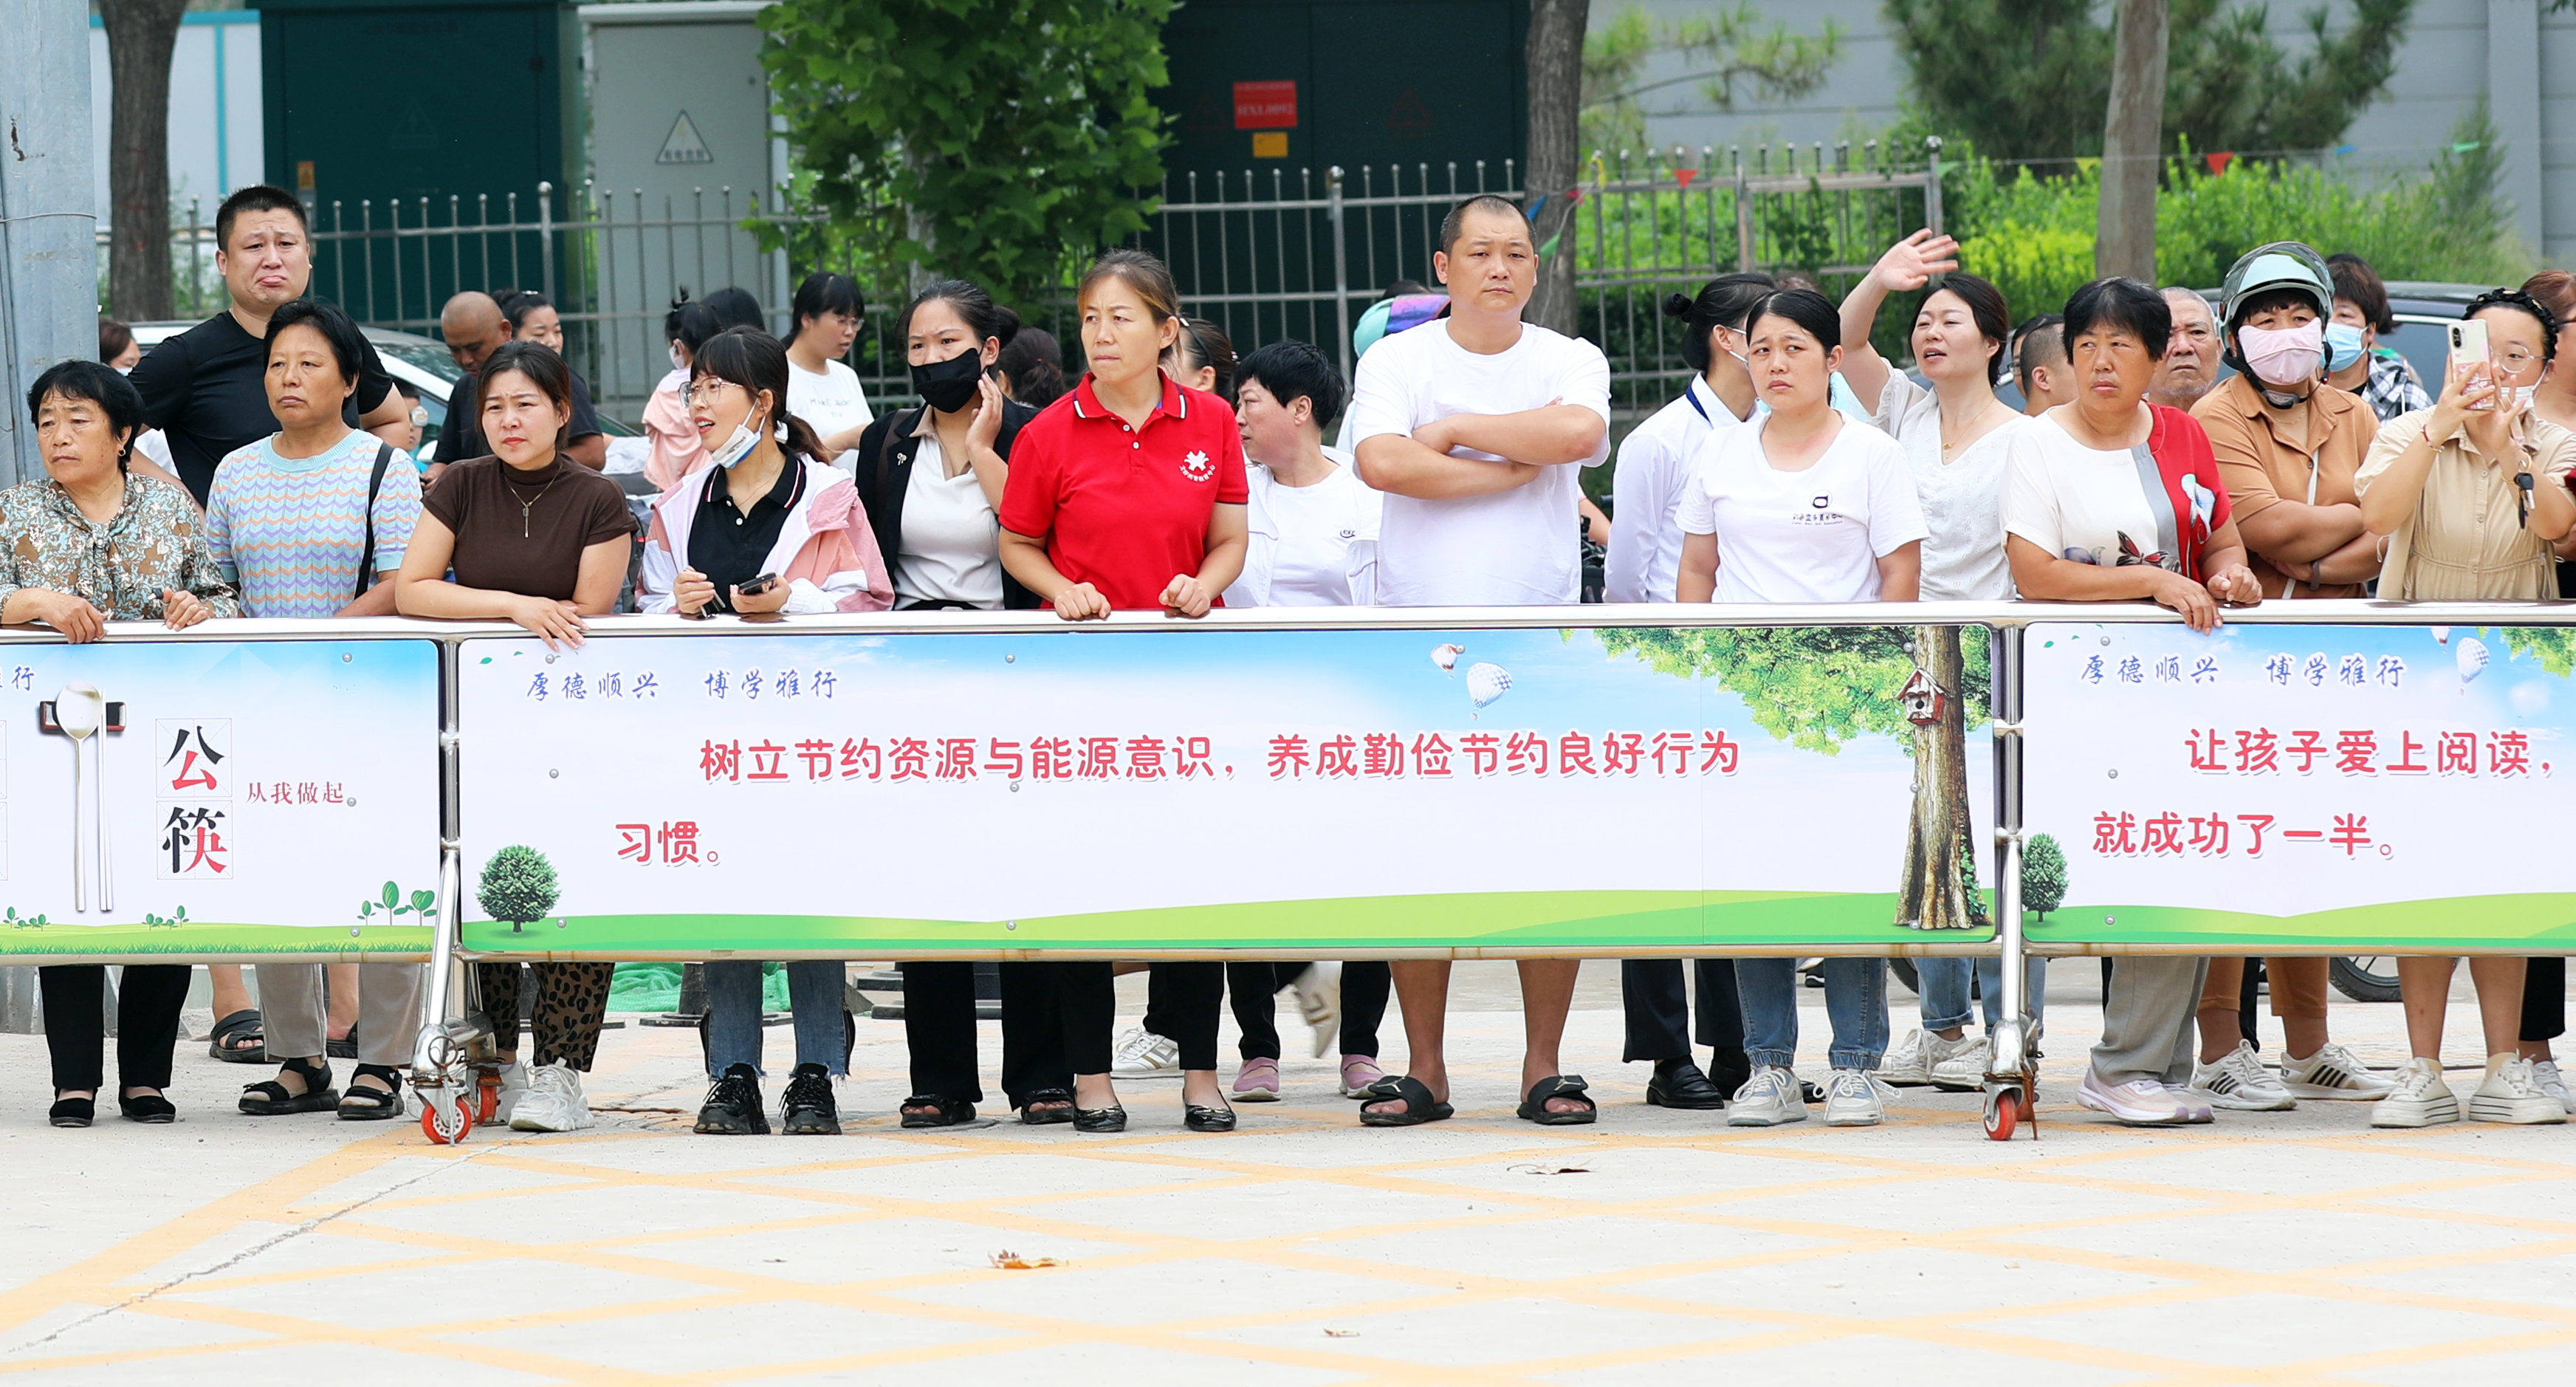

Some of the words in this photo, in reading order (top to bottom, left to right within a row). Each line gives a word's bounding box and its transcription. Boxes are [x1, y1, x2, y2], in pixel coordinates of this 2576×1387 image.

[2, 665, 35, 692] 行
[526, 671, 659, 701] 厚德顺兴
[704, 669, 838, 700] 博学雅行
[2081, 654, 2219, 685] 厚德顺兴
[2266, 653, 2405, 688] 博学雅行
[162, 725, 228, 874] 公筷
[615, 821, 718, 864] 习惯。
[2092, 810, 2394, 857] 就成功了一半。
